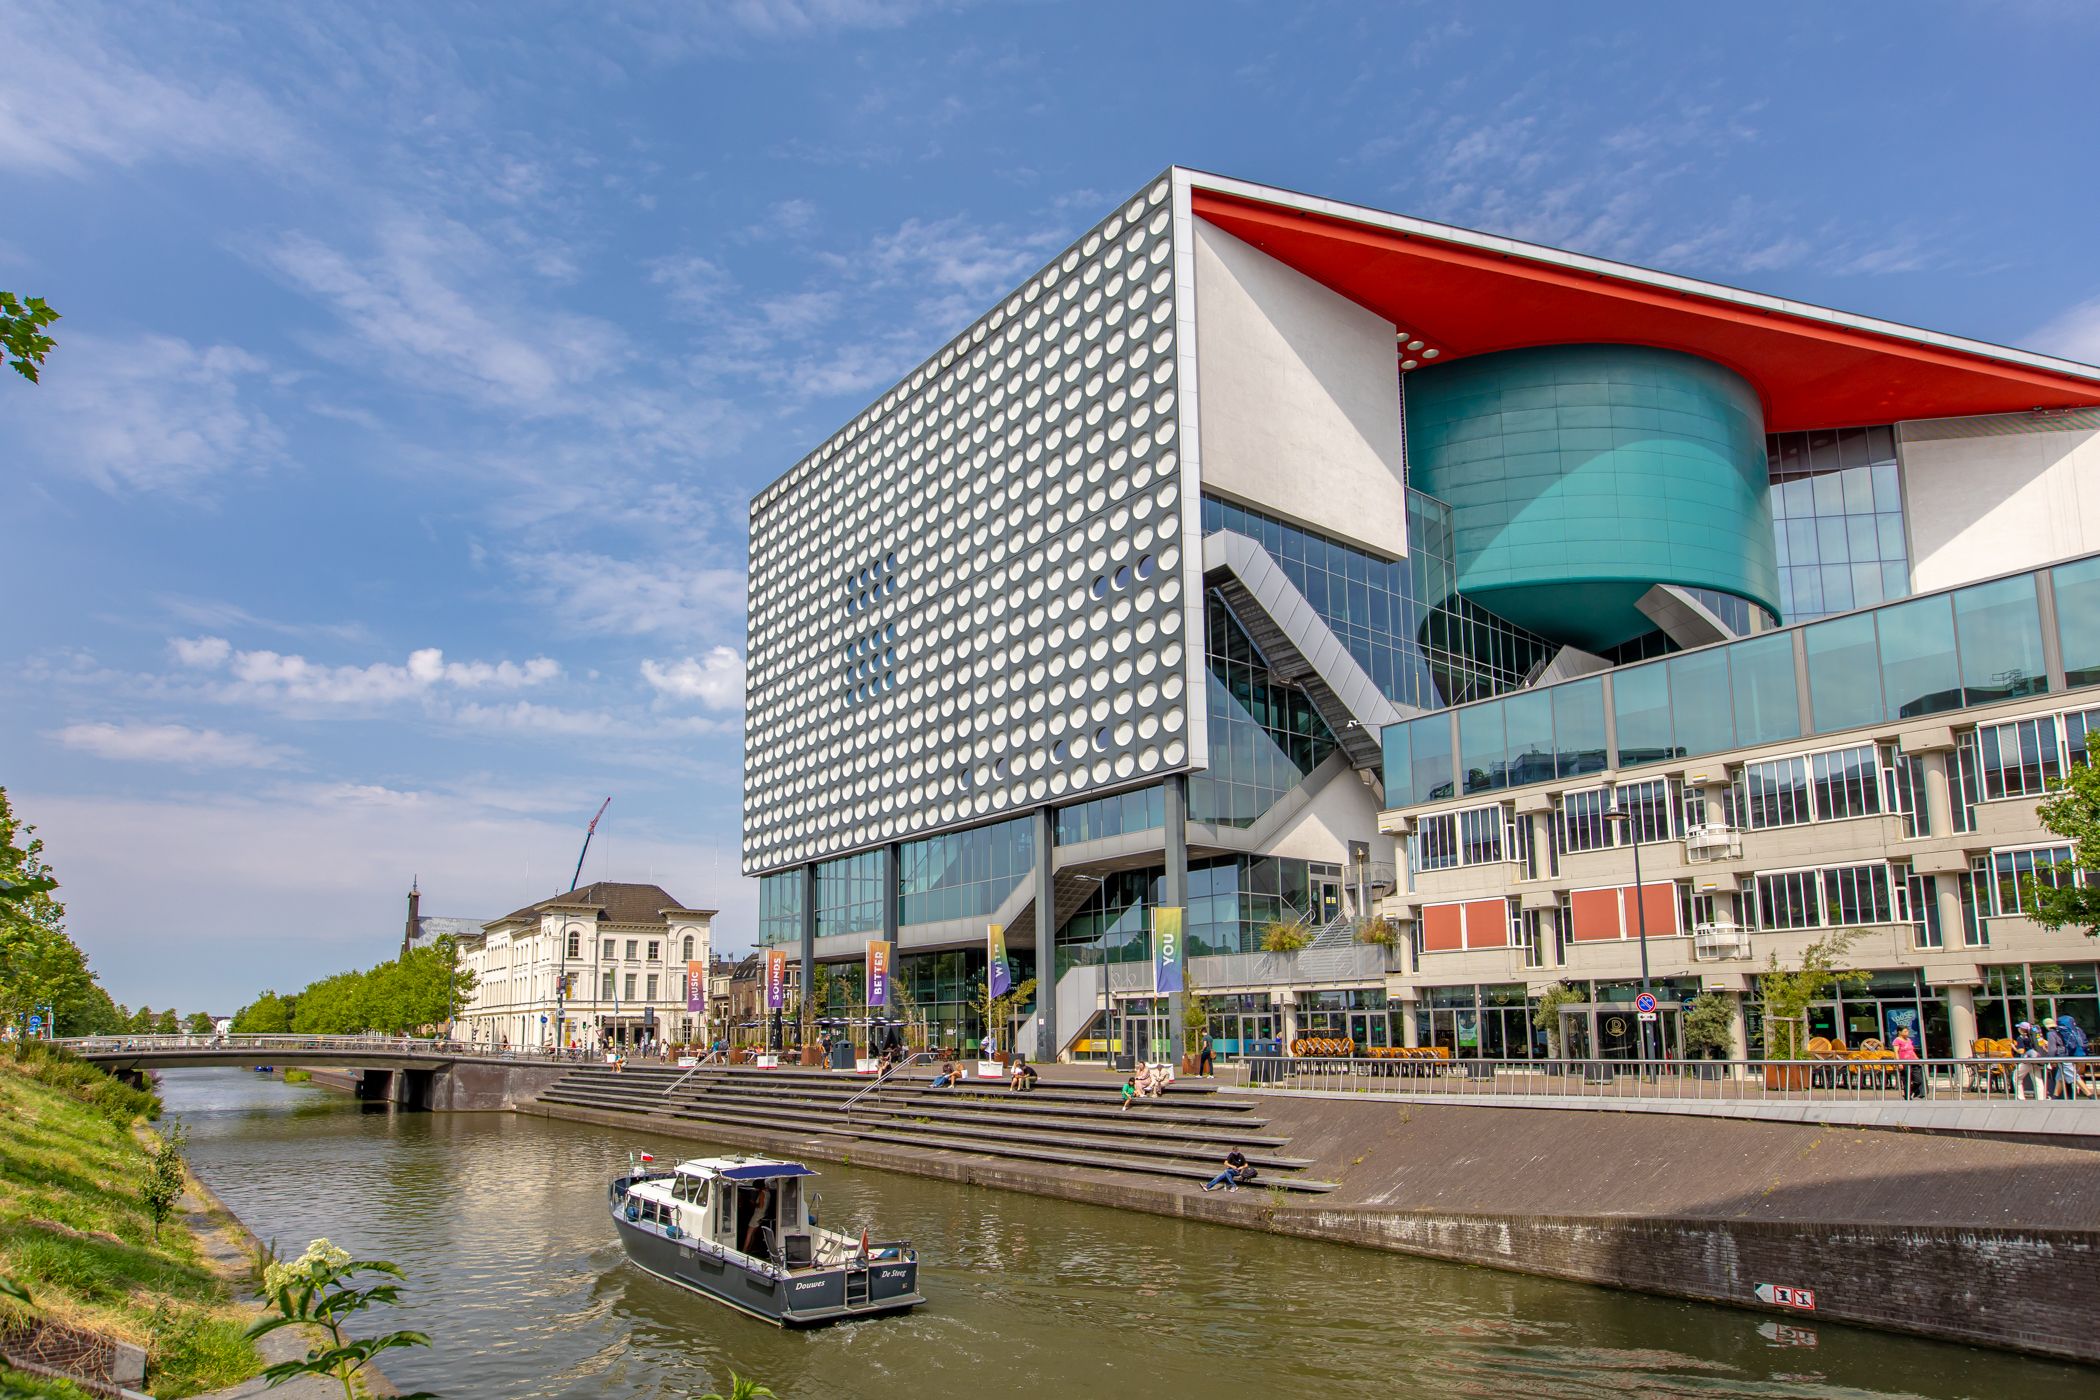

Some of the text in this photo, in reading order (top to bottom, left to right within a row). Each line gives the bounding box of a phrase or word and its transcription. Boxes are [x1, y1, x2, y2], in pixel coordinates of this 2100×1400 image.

[1163, 933, 1175, 966] YOU
[772, 958, 781, 1000] SOUNDS
[874, 951, 883, 995] BETTER
[795, 1280, 826, 1290] Douwes
[881, 1270, 891, 1278] De
